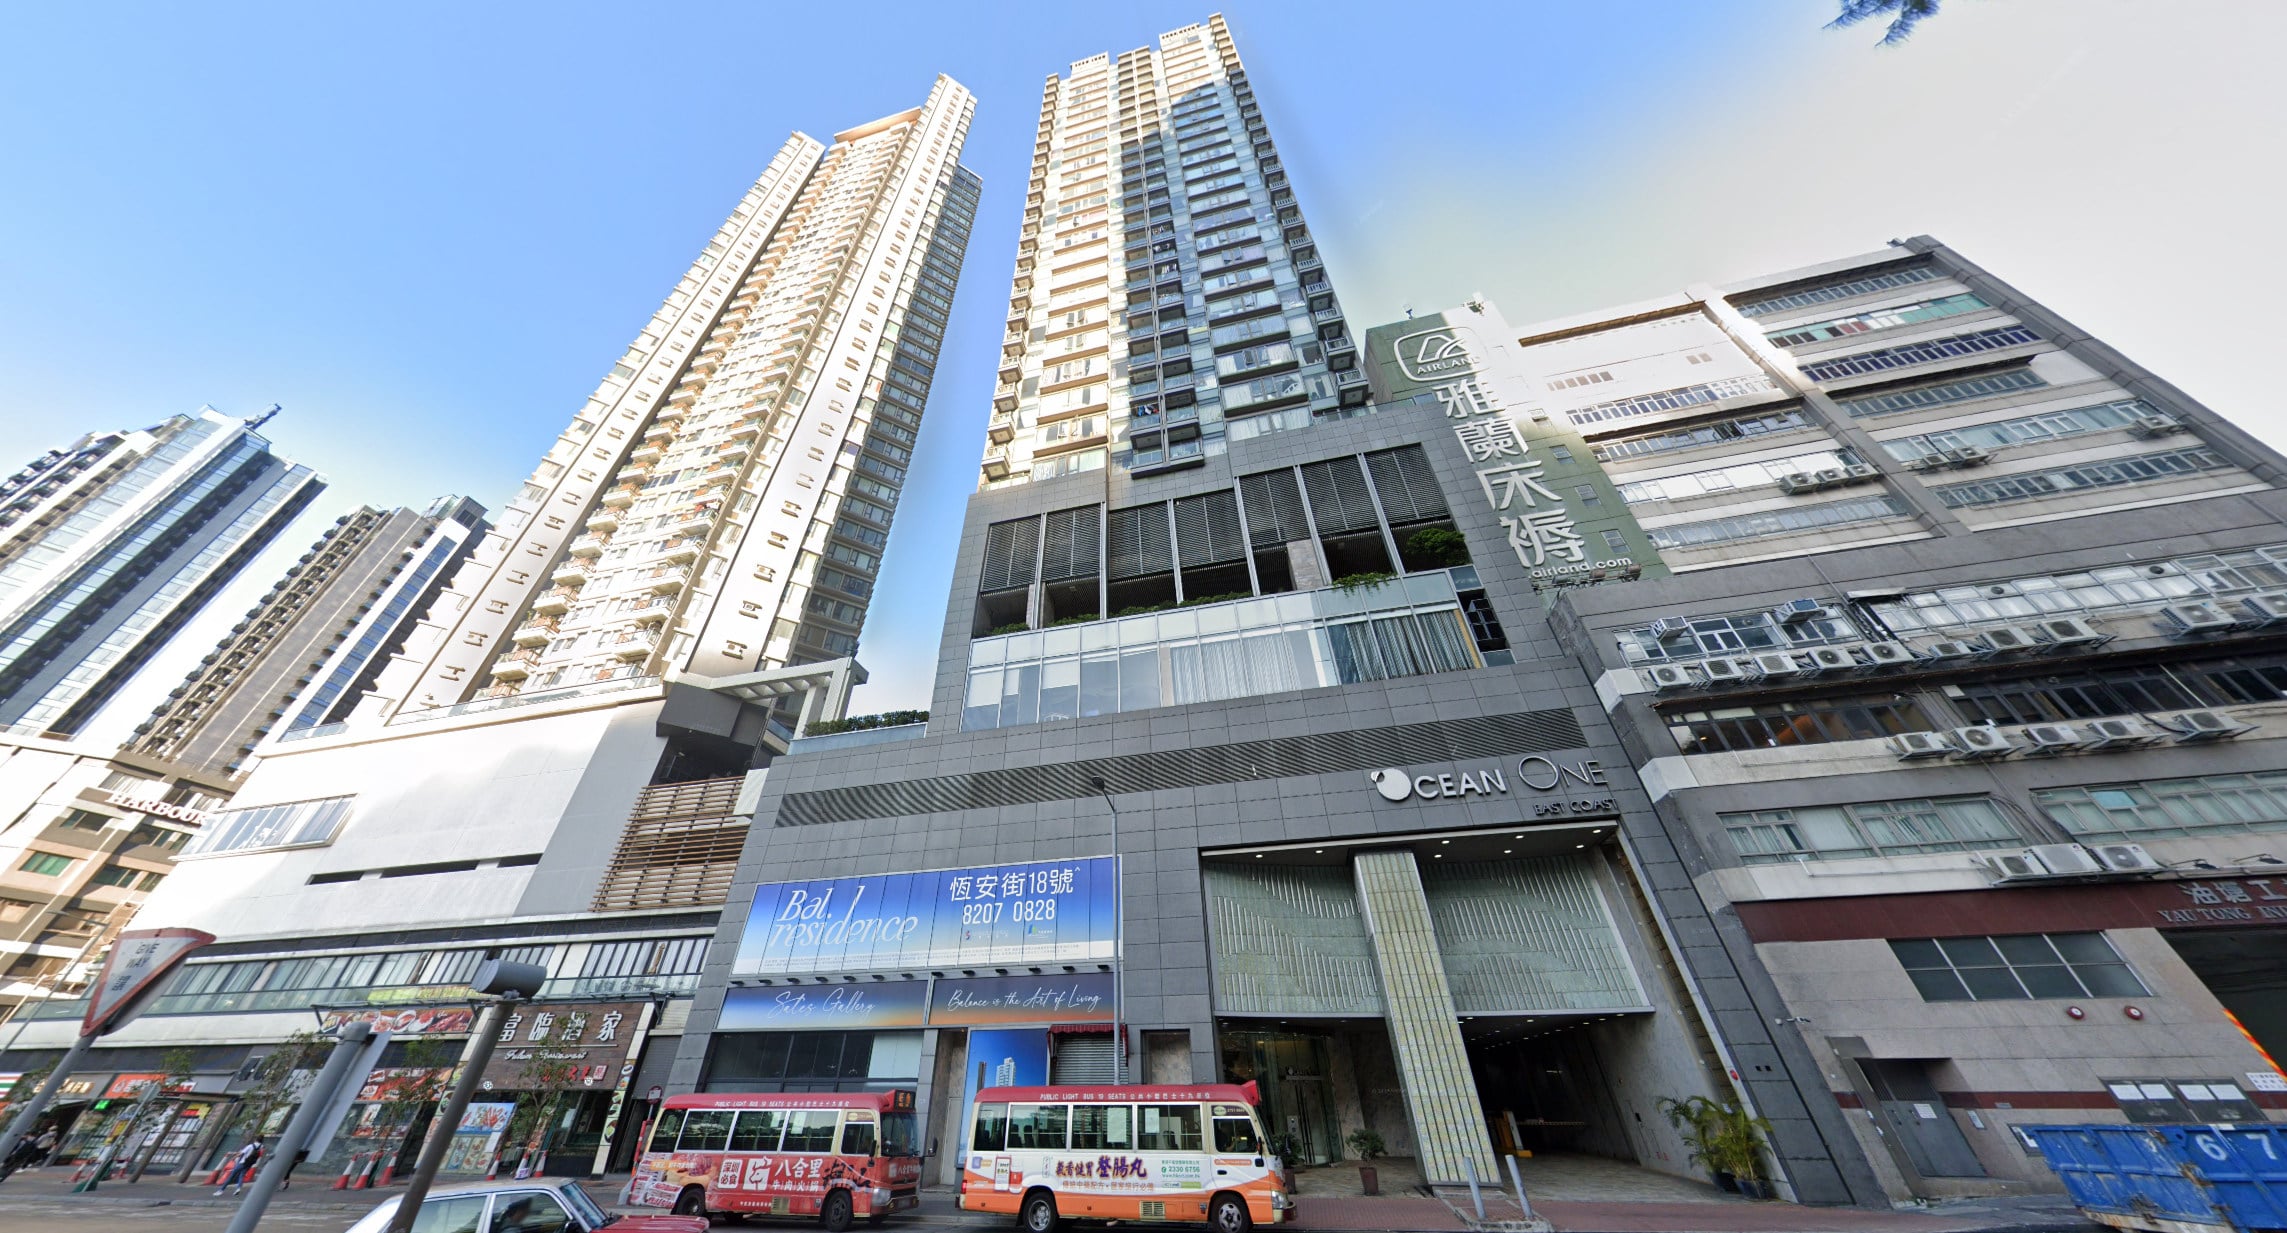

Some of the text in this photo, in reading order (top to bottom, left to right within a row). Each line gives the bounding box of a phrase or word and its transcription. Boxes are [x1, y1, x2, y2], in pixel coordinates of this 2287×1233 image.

[1518, 755, 1609, 790] ONE
[105, 789, 208, 826] HARBOUR
[1533, 797, 1619, 816] EAST COAST
[2177, 878, 2287, 905] 油塘工
[770, 885, 919, 947] residence
[962, 899, 1056, 925] 8207 0828
[2157, 909, 2198, 922] YAU
[2196, 907, 2252, 920] TONG
[768, 987, 876, 1022] Sales Gallery
[947, 989, 988, 1012] Balance
[1004, 991, 1020, 1008] the
[1023, 986, 1057, 1009] Art
[1054, 991, 1066, 1011] of
[1068, 984, 1102, 1012] Living
[1039, 1093, 1059, 1101] PUBLIC
[1062, 1093, 1079, 1101] LIGHT
[774, 1157, 823, 1179] 八合里
